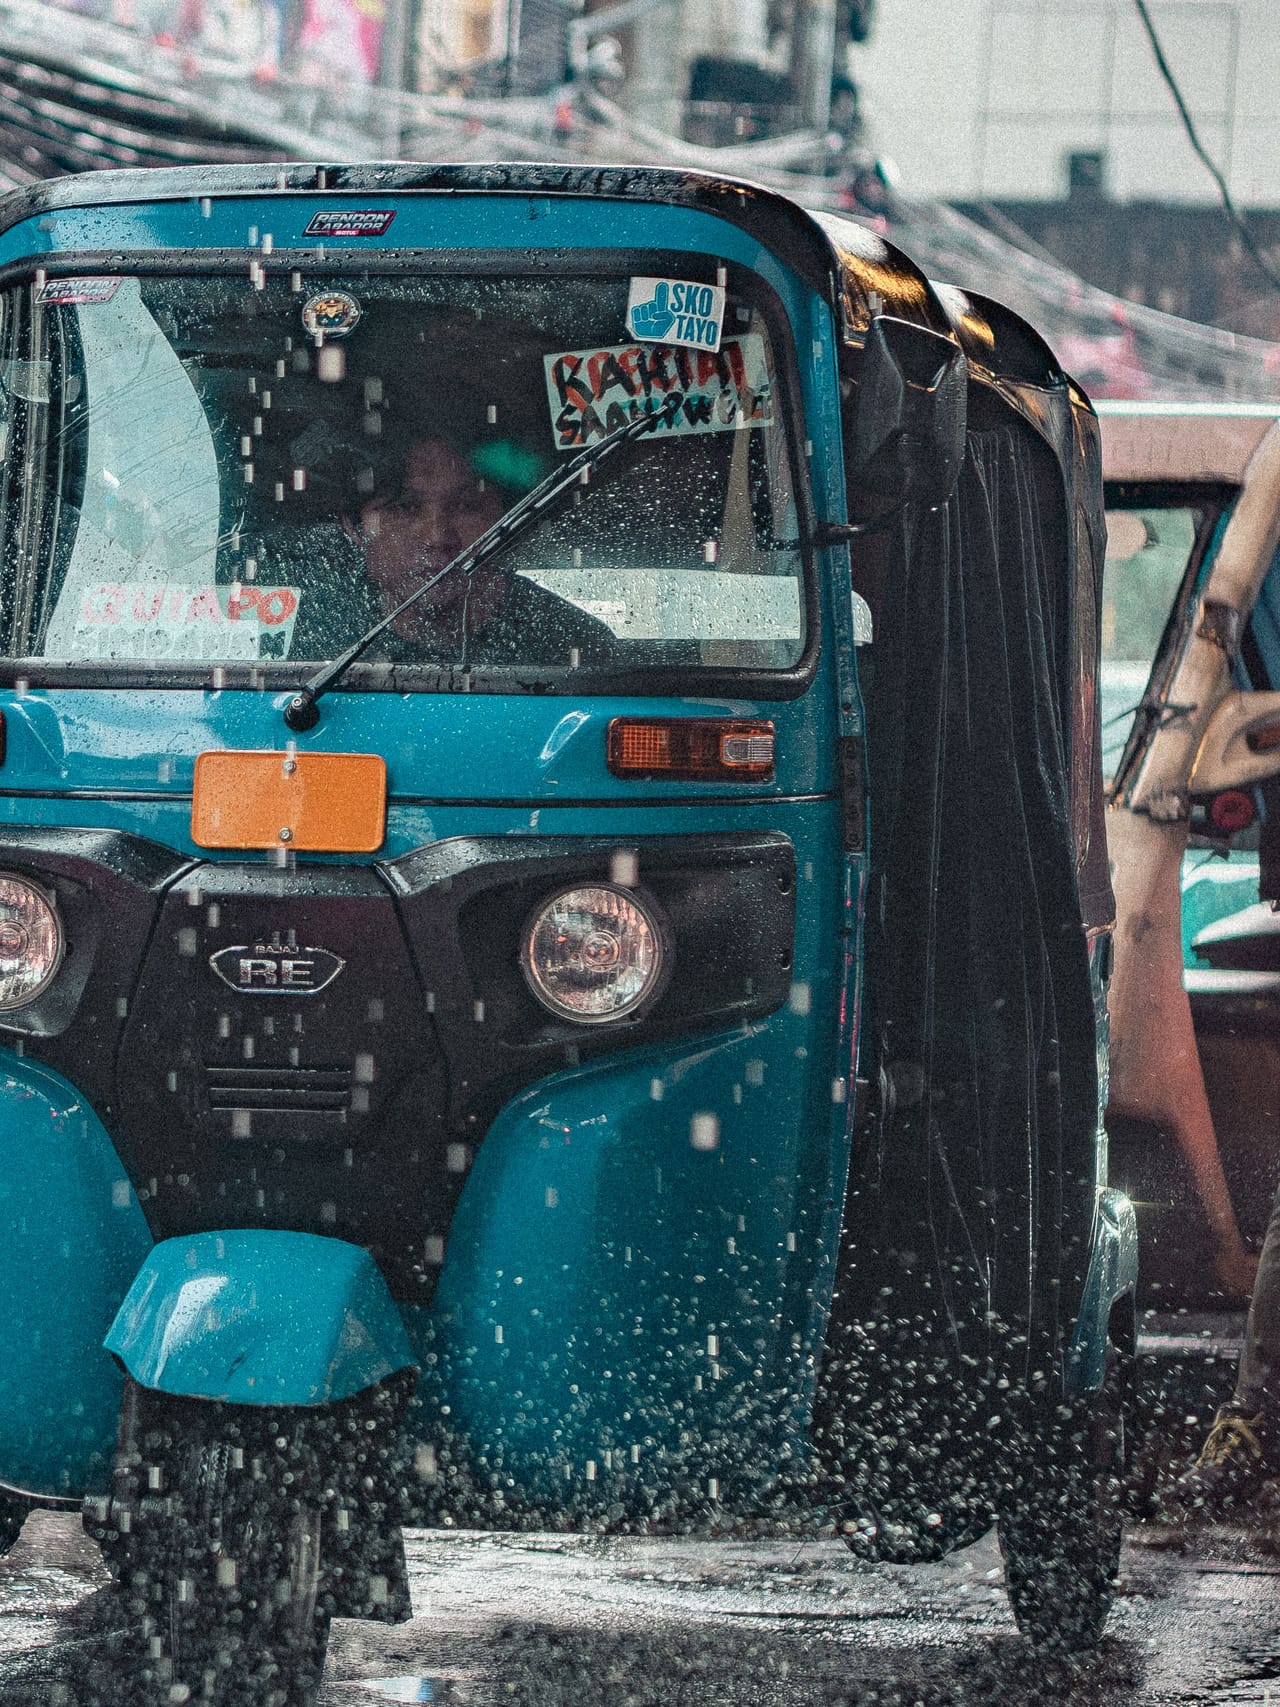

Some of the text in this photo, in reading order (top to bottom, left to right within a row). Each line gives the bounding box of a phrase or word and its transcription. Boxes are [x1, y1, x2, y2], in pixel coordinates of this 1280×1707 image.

[311, 222, 383, 231] LABADOR
[314, 213, 390, 223] RENDON
[41, 288, 109, 300] LABADOR
[44, 280, 115, 292] RENDON
[670, 282, 713, 317] SKO
[676, 315, 718, 346] TAYO
[81, 585, 297, 626] QUIAPO
[240, 958, 314, 985] RE
